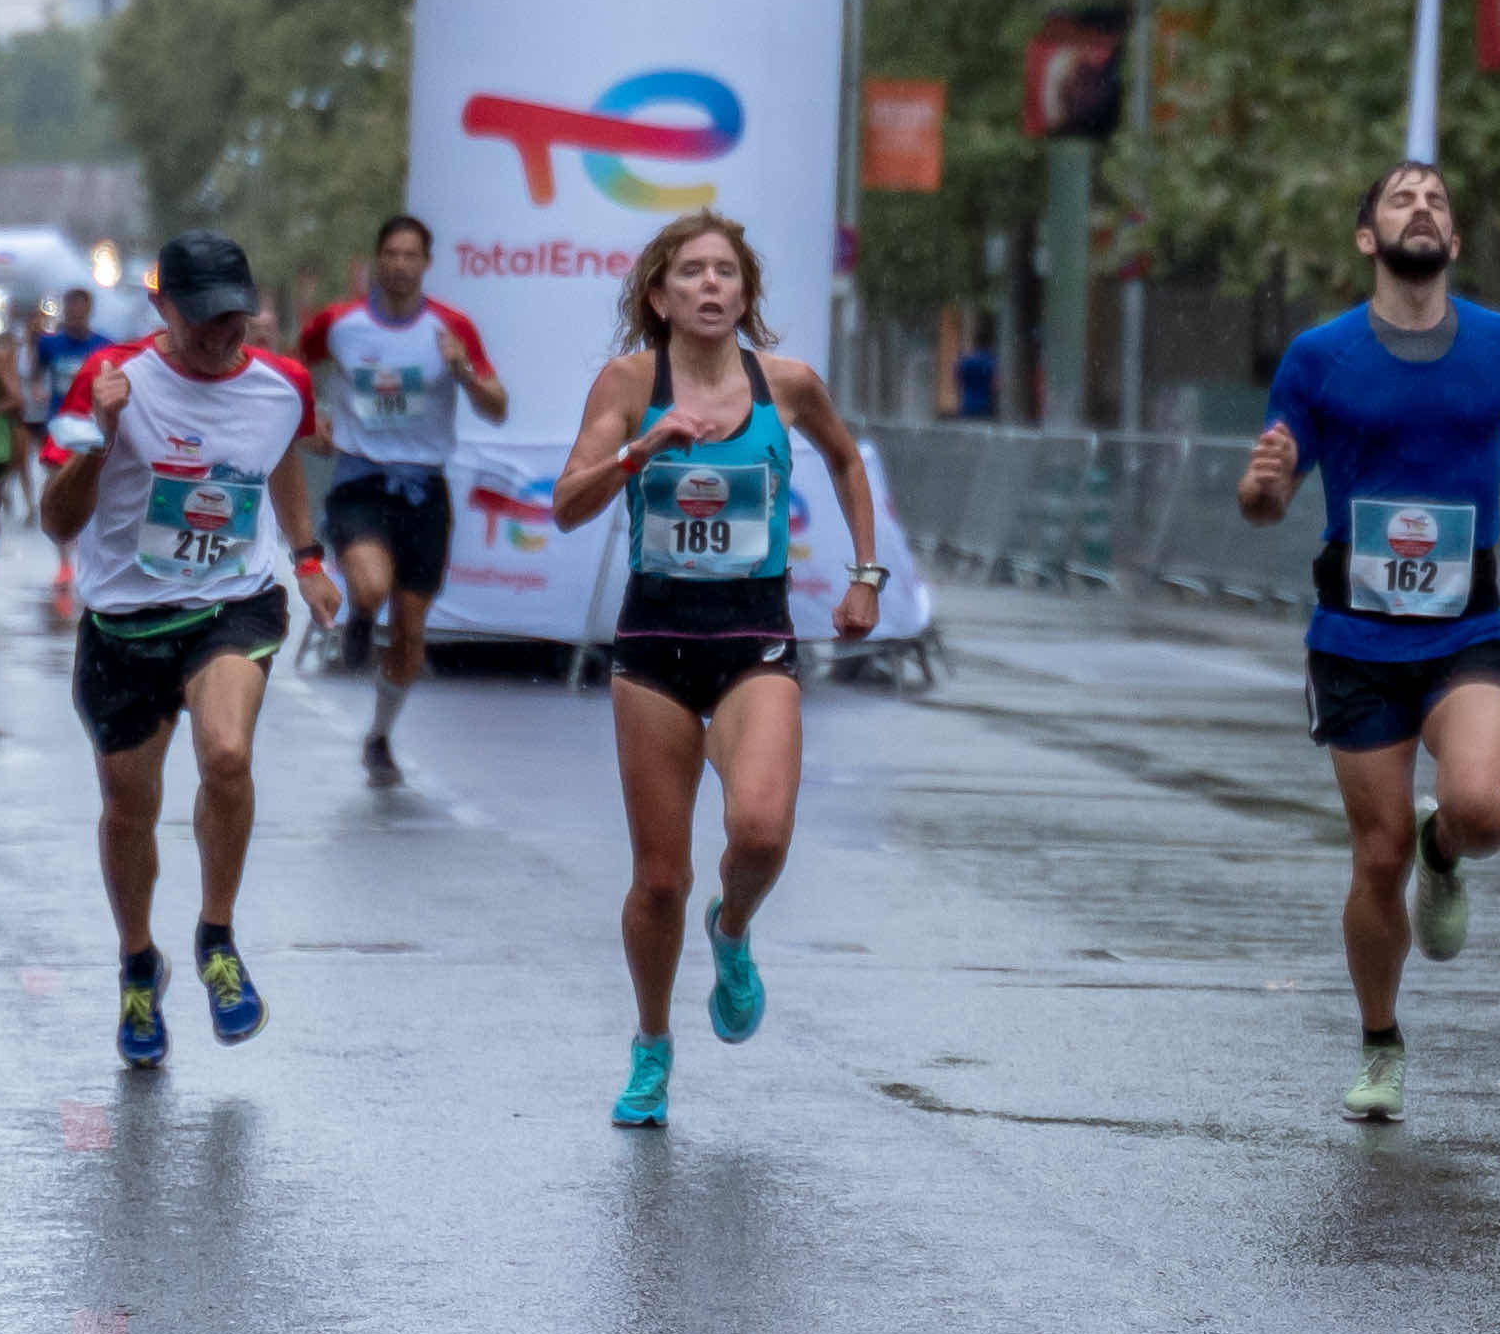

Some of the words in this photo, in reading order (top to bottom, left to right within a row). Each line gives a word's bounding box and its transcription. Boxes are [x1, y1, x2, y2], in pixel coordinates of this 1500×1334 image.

[455, 240, 638, 277] TotalEne
[174, 530, 228, 564] 215
[673, 520, 731, 554] 189
[1384, 560, 1438, 593] 162
